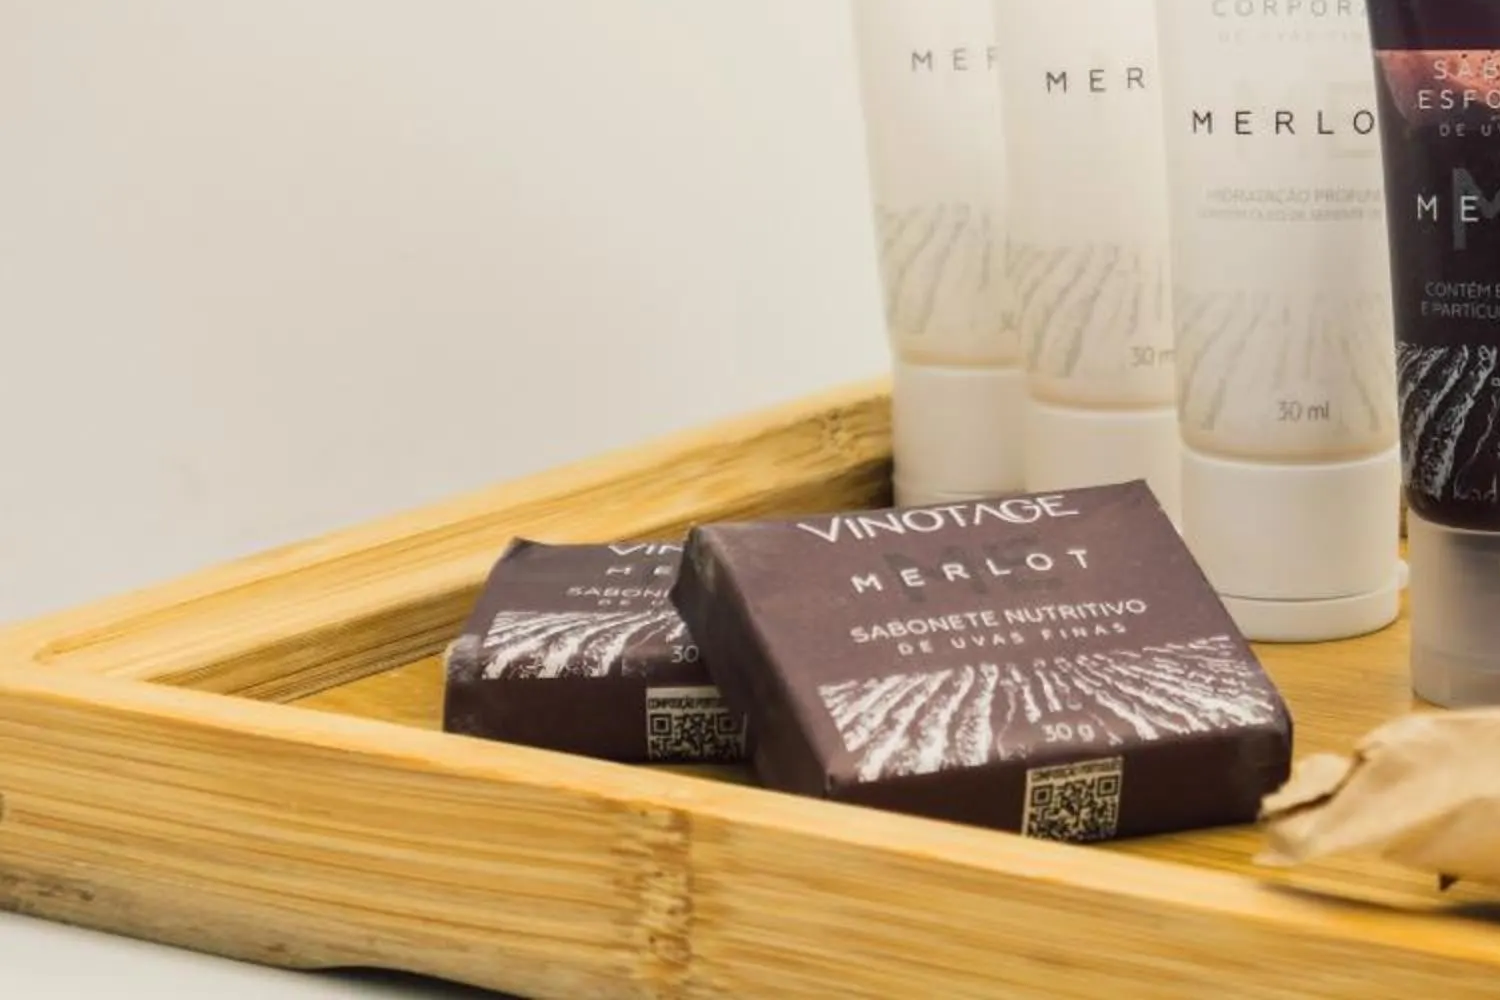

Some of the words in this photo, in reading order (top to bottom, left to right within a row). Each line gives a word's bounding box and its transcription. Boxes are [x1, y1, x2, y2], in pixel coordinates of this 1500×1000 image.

[1192, 109, 1375, 135] MERLO
[1438, 122, 1466, 138] DE
[1275, 399, 1303, 422] 30
[1306, 399, 1331, 422] ml
[797, 494, 1081, 545] VINOTAGE
[850, 547, 1090, 596] MERLOT
[849, 608, 1000, 646] SABONETE
[1003, 598, 1149, 626] NUTRITIVO
[897, 637, 934, 657] DE
[951, 630, 1026, 652] UVAS
[1041, 621, 1128, 643] FINAS
[670, 644, 700, 664] 30
[1041, 721, 1074, 744] 30
